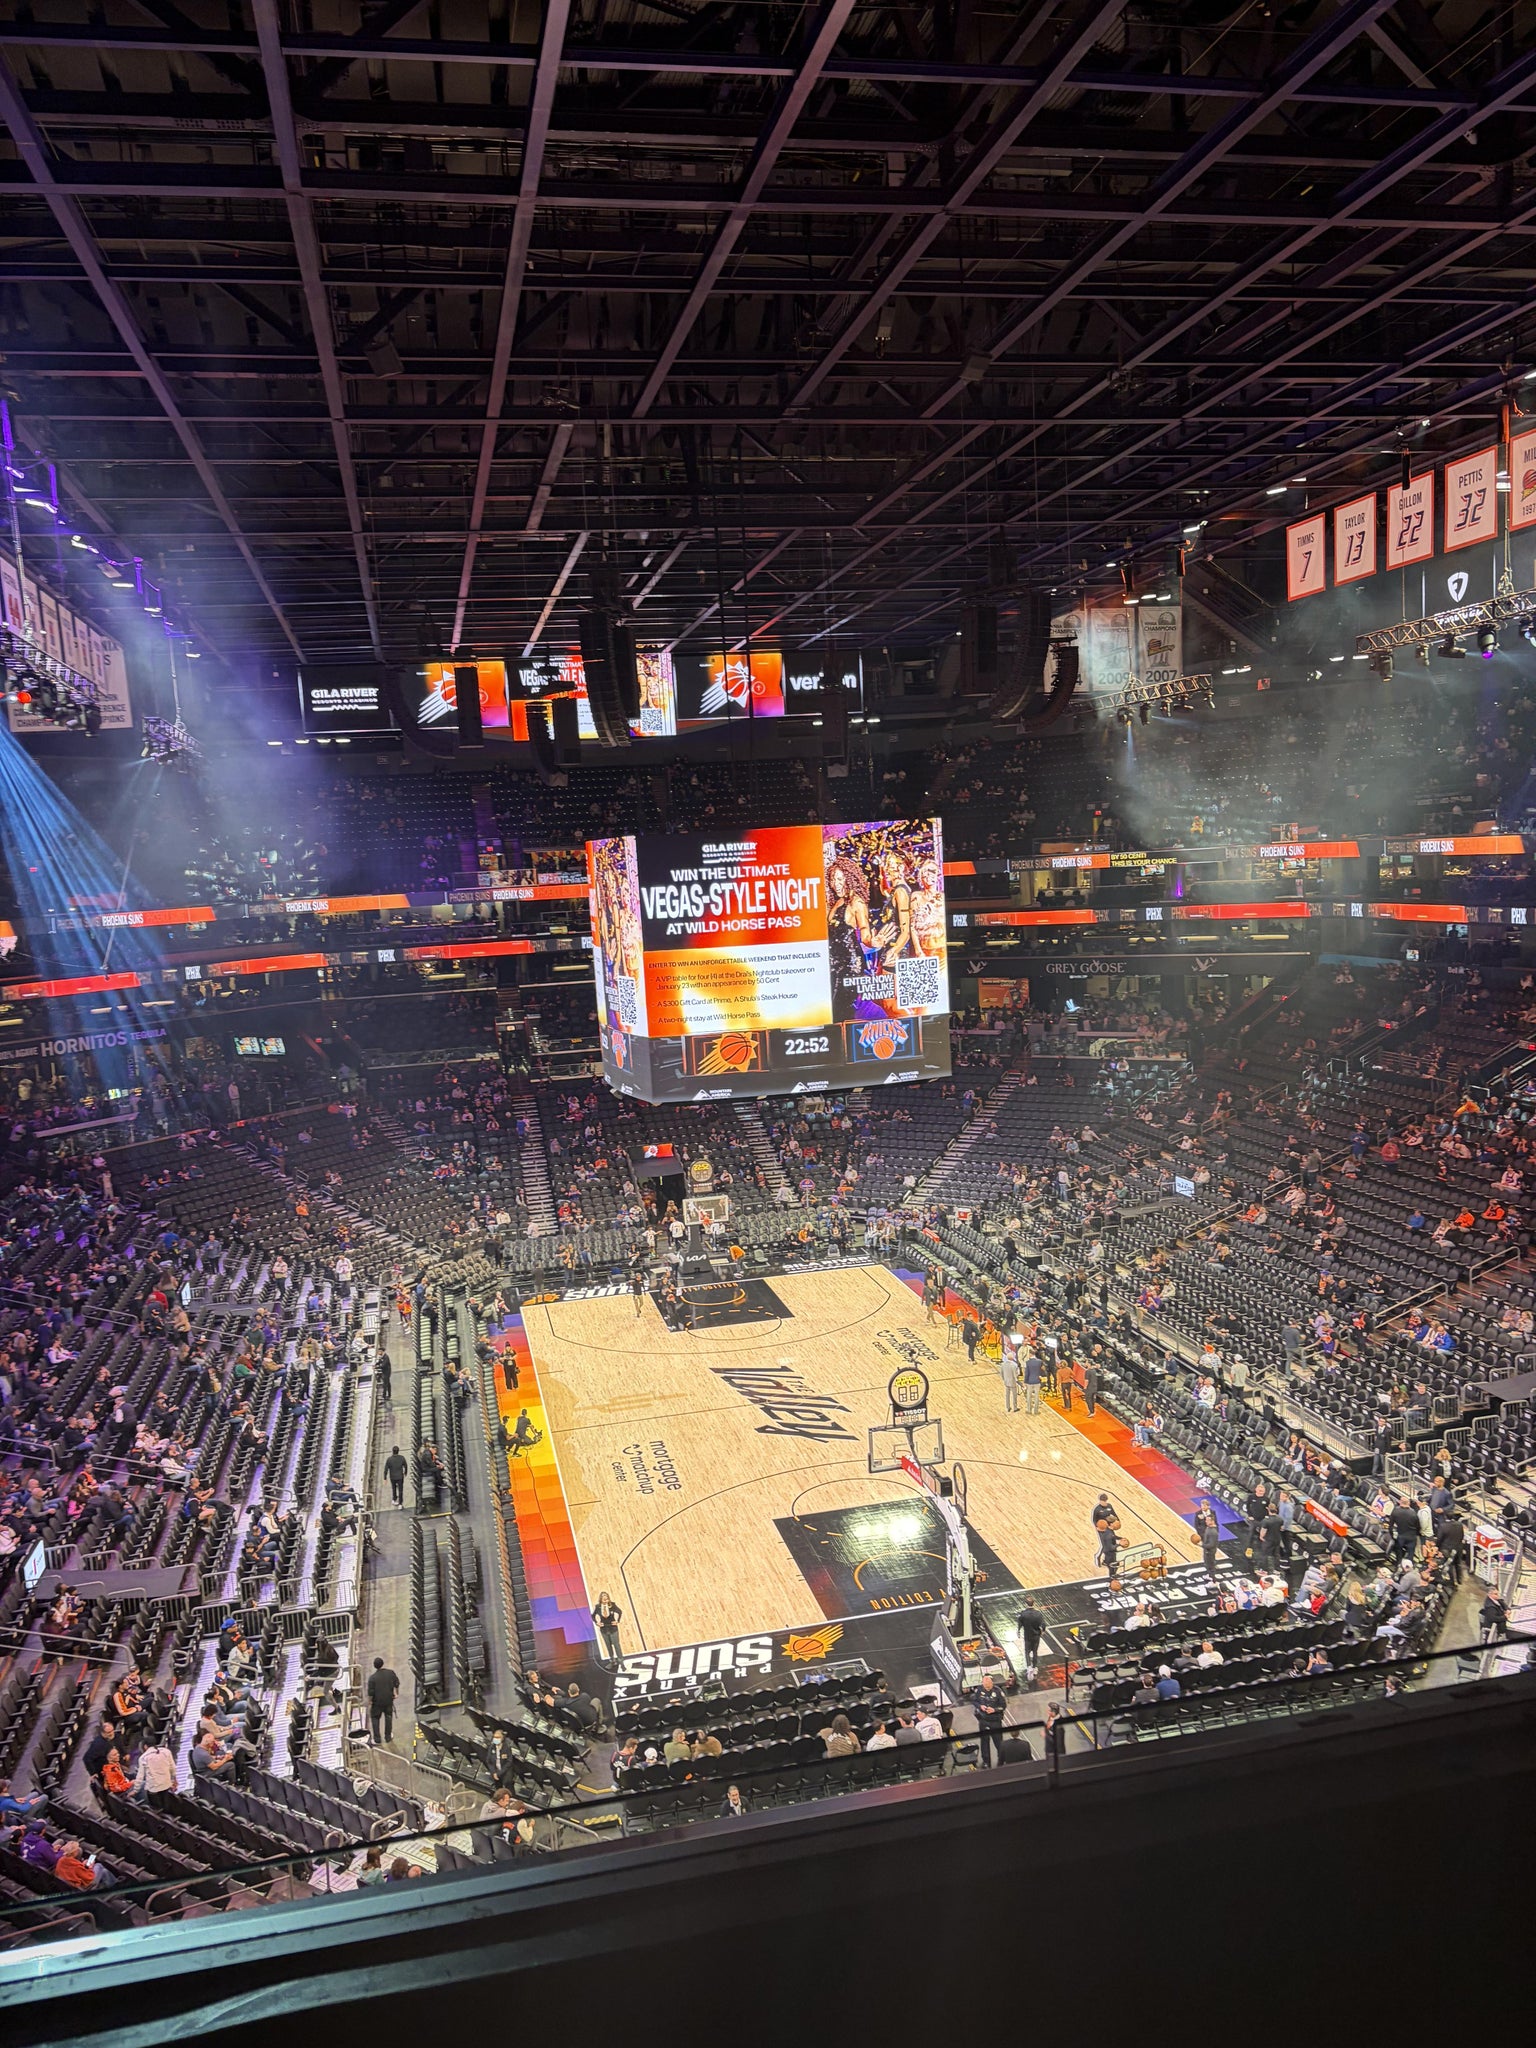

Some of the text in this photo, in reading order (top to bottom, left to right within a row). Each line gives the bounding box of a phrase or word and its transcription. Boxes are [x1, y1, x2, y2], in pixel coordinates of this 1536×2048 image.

[1458, 468, 1483, 488] PETTIS
[1399, 491, 1423, 510] GILLOM
[1454, 487, 1487, 532] 32
[1344, 512, 1365, 530] TAYLOR
[1396, 510, 1425, 551] 22
[1297, 532, 1314, 548] TIMMS
[1344, 530, 1366, 567] 13
[1299, 550, 1312, 582] 7
[1145, 669, 1178, 683] 2007
[311, 687, 379, 698] GILA RIVER
[702, 842, 758, 853] GILA RIVER
[1260, 845, 1305, 857] PHOENIX SUNS
[1420, 840, 1440, 853] PHOENIX
[1440, 840, 1454, 852] SUNS
[1011, 858, 1050, 870] PHOENIX SUNS
[1052, 856, 1092, 868] PHOENIX SUNS
[1151, 857, 1178, 865] CHANCE
[670, 863, 790, 882] WIN THE ULTIMATE
[492, 889, 534, 900] PHOENIX SUNS
[641, 877, 821, 919] VEGAS-STYLE NIGHT
[285, 901, 312, 912] PHOENIX
[312, 900, 329, 911] SUNS
[1351, 903, 1364, 917] PHX
[102, 914, 128, 927] PHOENIX
[128, 913, 144, 925] SUNS
[953, 914, 968, 927] PHX
[1145, 907, 1163, 921] PHX
[1511, 907, 1528, 924] PHX
[666, 915, 802, 935] AT WILD HORSE PASS
[377, 949, 396, 962] PHX
[699, 957, 748, 966] UNFORGETTABLE
[748, 955, 777, 963] WEEKEND
[777, 953, 791, 961] THAT
[185, 966, 201, 980] PHX
[1046, 960, 1127, 974] GREY GOOSE
[765, 976, 780, 984] Cent
[843, 976, 871, 987] ENTER
[857, 982, 894, 993] LIVE LIKE
[663, 999, 679, 1008] $300
[862, 992, 874, 1001] AN
[859, 1019, 909, 1046] KNICKS
[41, 1031, 128, 1057] HORNITOS
[130, 1028, 167, 1041] TEQUILA
[784, 1036, 829, 1055] 22:52
[611, 1461, 628, 1482] center
[649, 1440, 682, 1491] mortgage
[630, 1456, 655, 1494] matchup
[869, 1590, 934, 1610] EDITION
[614, 1636, 773, 1687] SUNS
[613, 1663, 772, 1698] PHOENIX
